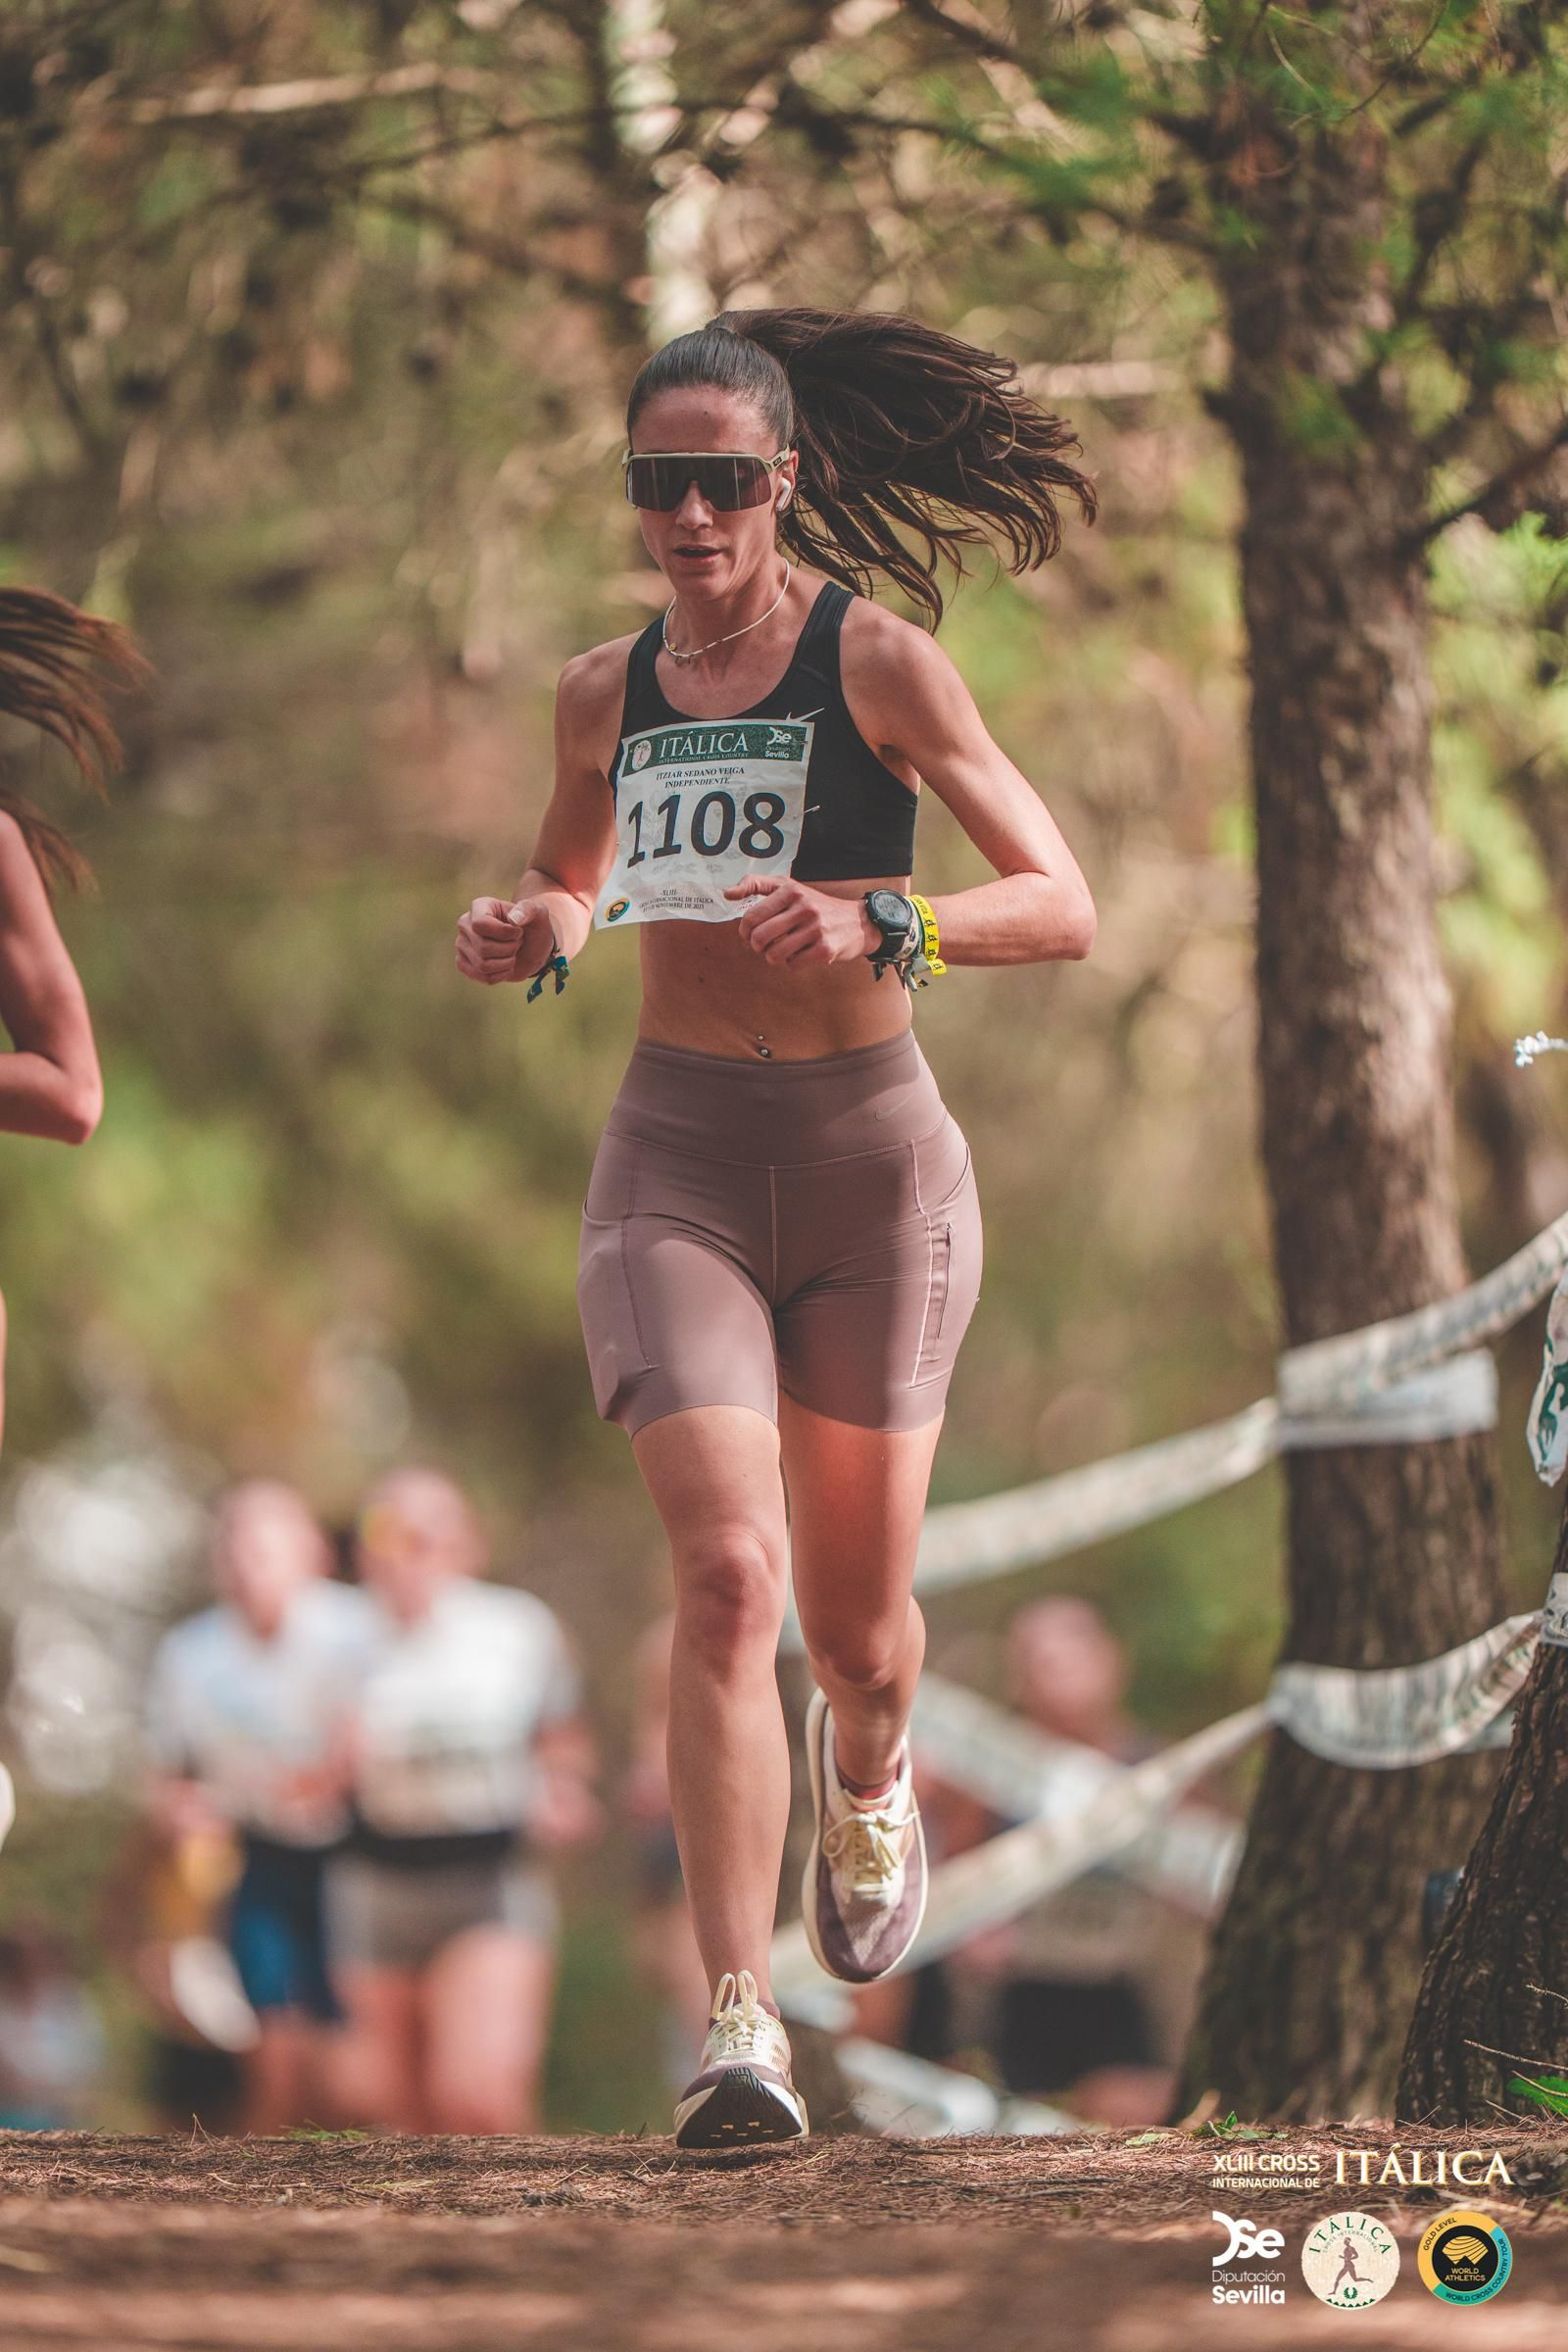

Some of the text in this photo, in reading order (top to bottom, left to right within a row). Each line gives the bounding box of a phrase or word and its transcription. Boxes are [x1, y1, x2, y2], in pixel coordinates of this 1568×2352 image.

[659, 730, 749, 759] ITÁLICA
[764, 750, 789, 760] Sevilla
[657, 766, 745, 781] ITZIAR SEDANO VEIGA
[664, 777, 730, 790] INDEPENDIENTE
[627, 791, 785, 868] 1108
